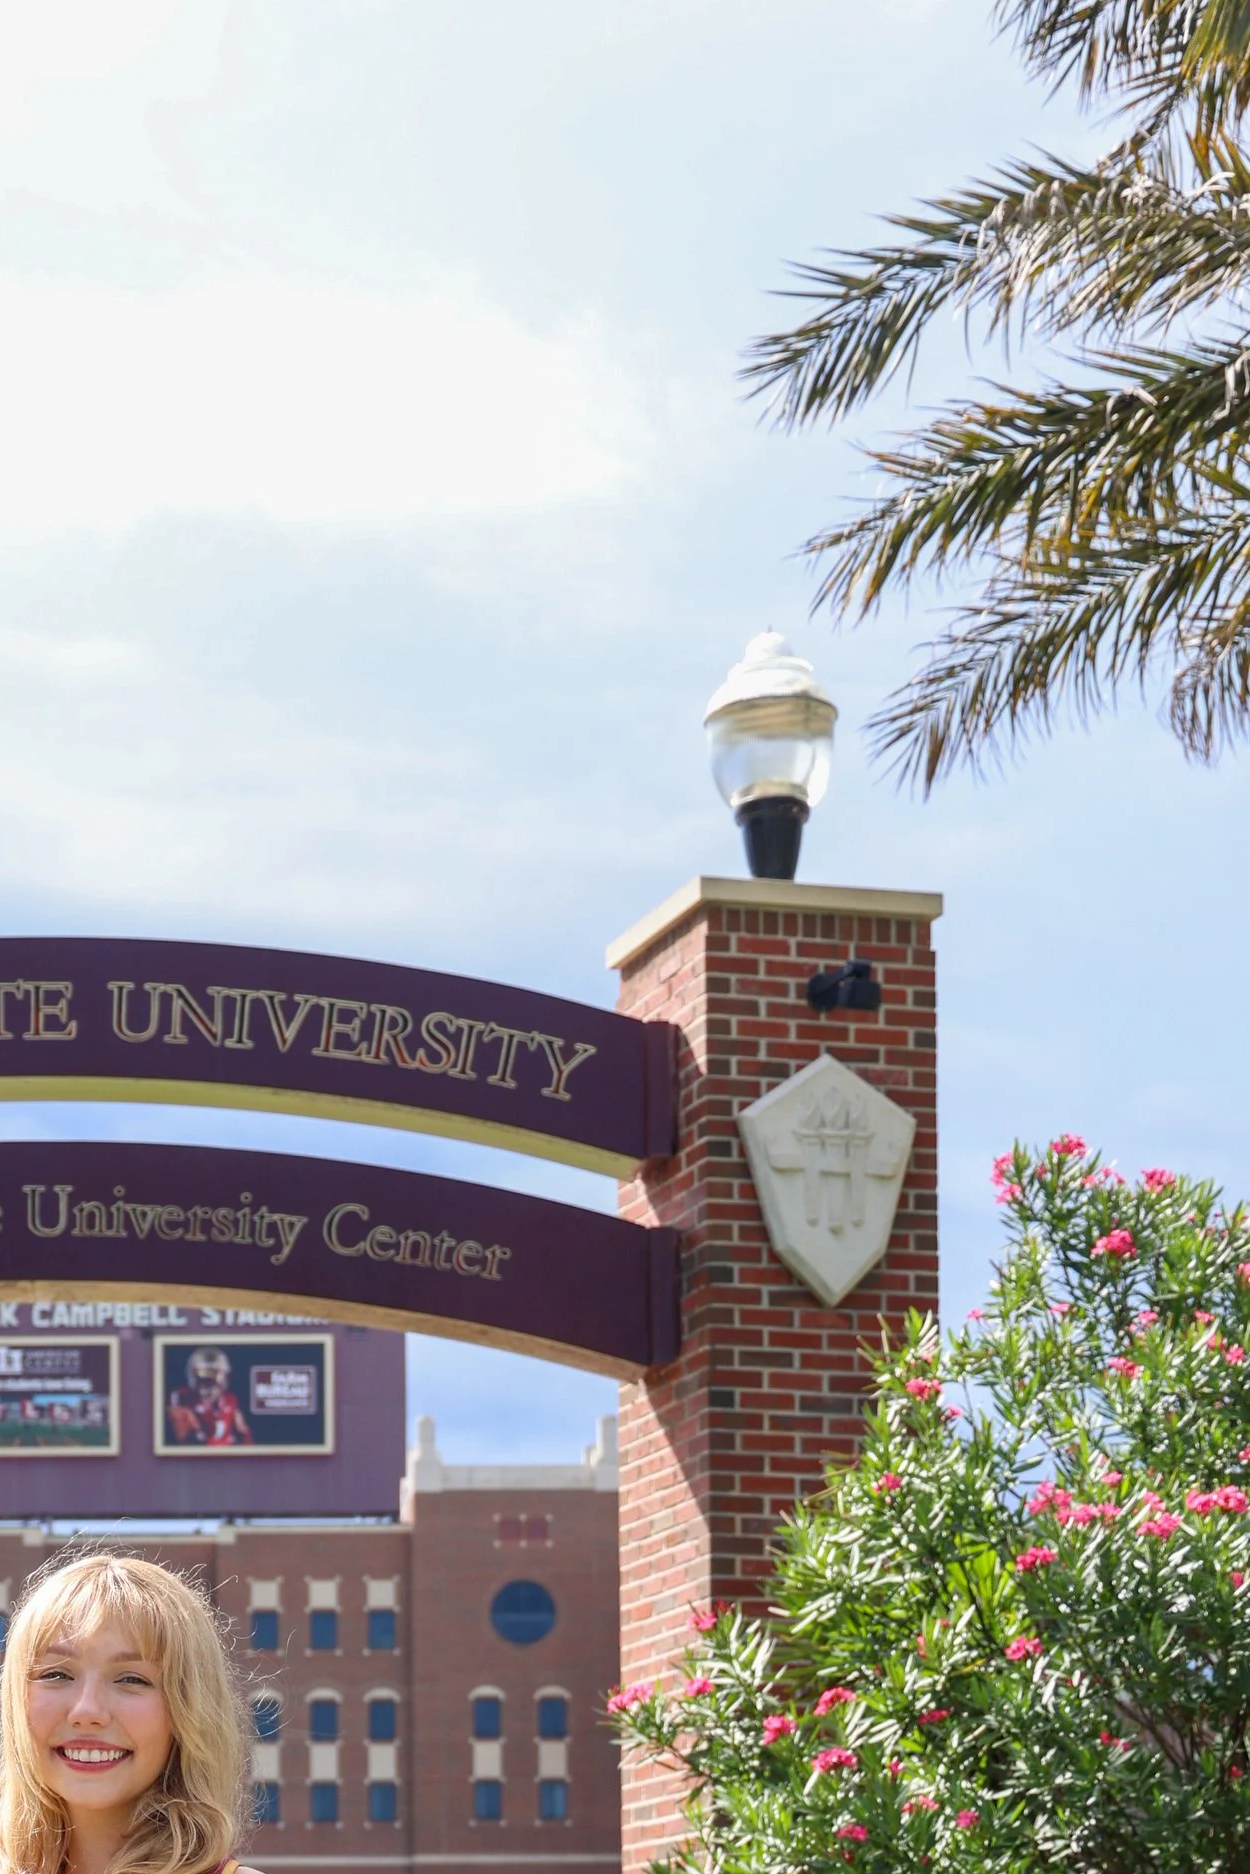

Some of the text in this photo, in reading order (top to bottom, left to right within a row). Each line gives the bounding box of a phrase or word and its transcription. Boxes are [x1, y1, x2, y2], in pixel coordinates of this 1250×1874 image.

[107, 980, 597, 1101] UNIVERSITY
[23, 1184, 308, 1266] University
[322, 1203, 512, 1281] Center
[31, 1302, 188, 1328] CAMPBELL
[201, 1306, 331, 1326] STAD
